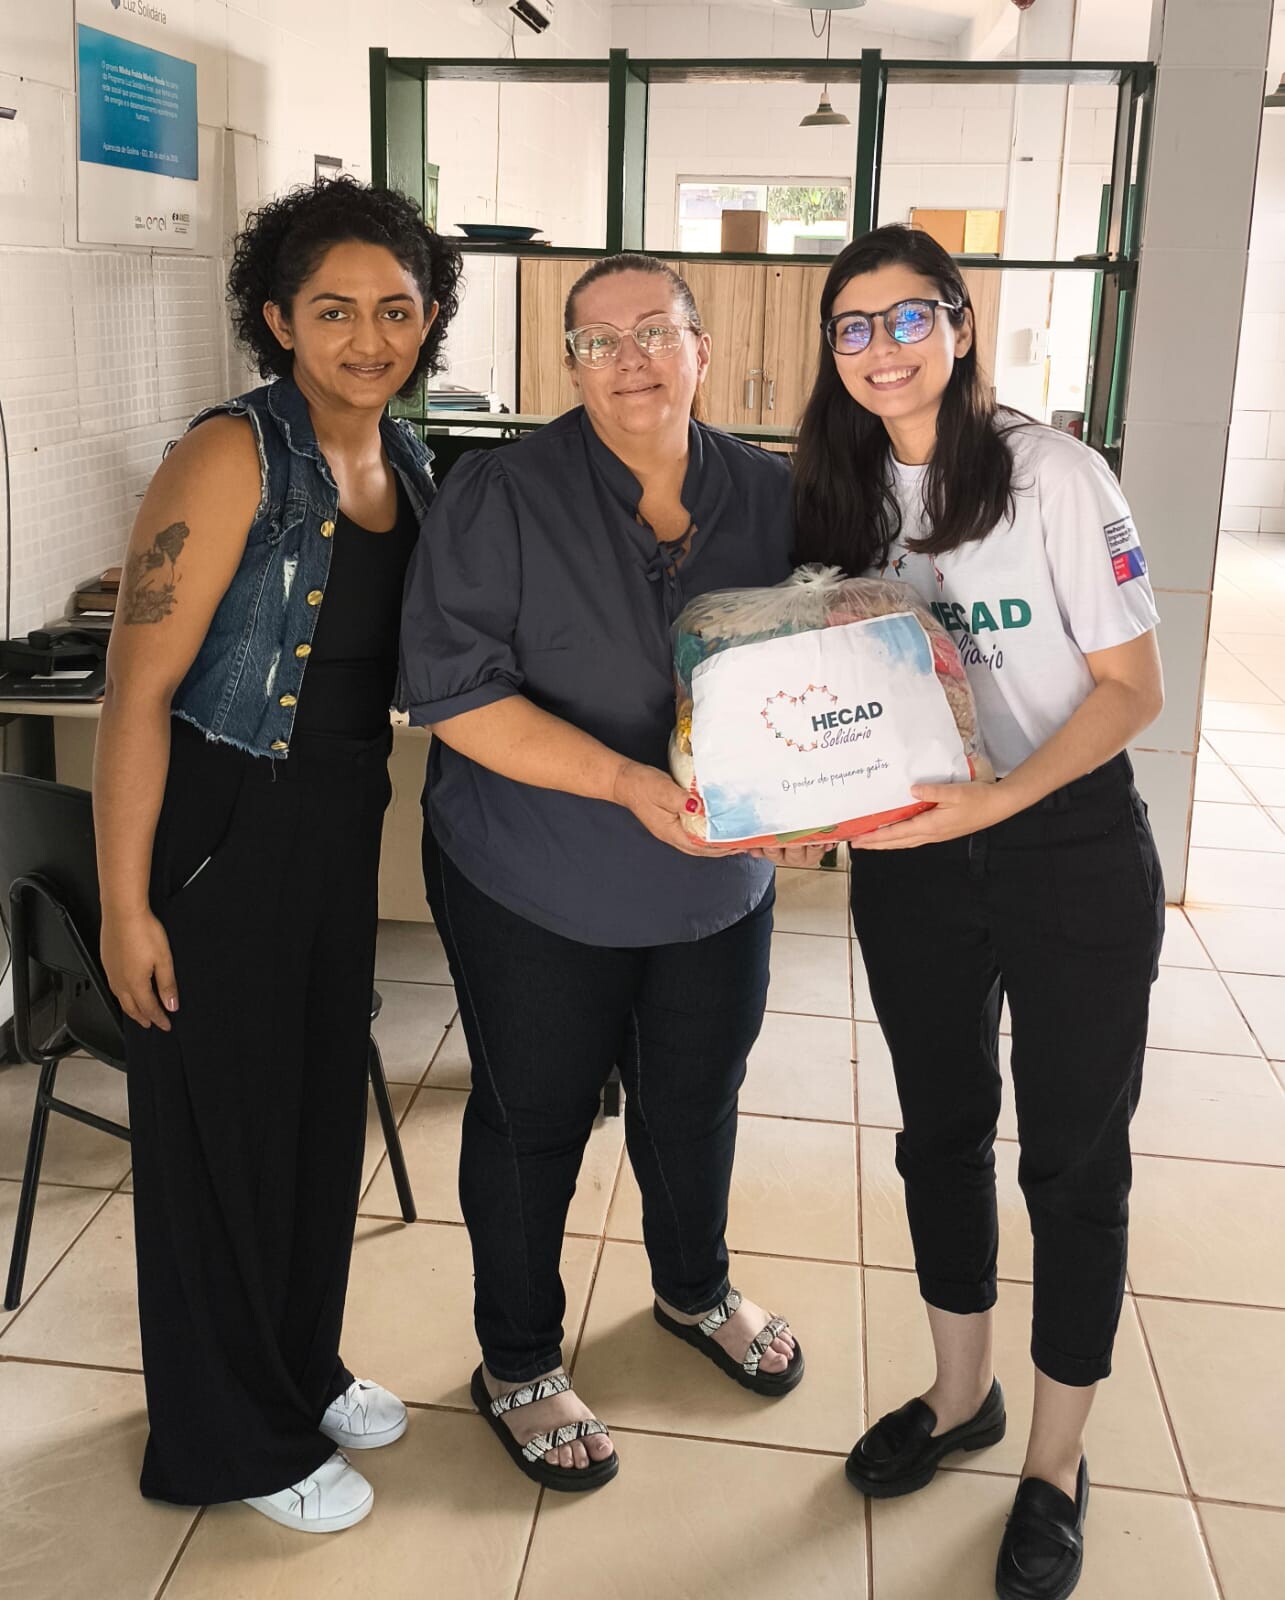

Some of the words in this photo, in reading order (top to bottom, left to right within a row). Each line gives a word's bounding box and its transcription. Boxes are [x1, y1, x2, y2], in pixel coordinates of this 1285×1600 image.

[122, 0, 136, 13] Luz
[811, 701, 883, 732] HECAD
[820, 726, 872, 749] Solidário
[782, 779, 790, 791] O
[792, 776, 814, 794] poder
[817, 772, 829, 784] de
[830, 767, 864, 786] pequenos
[866, 758, 889, 778] gestos
